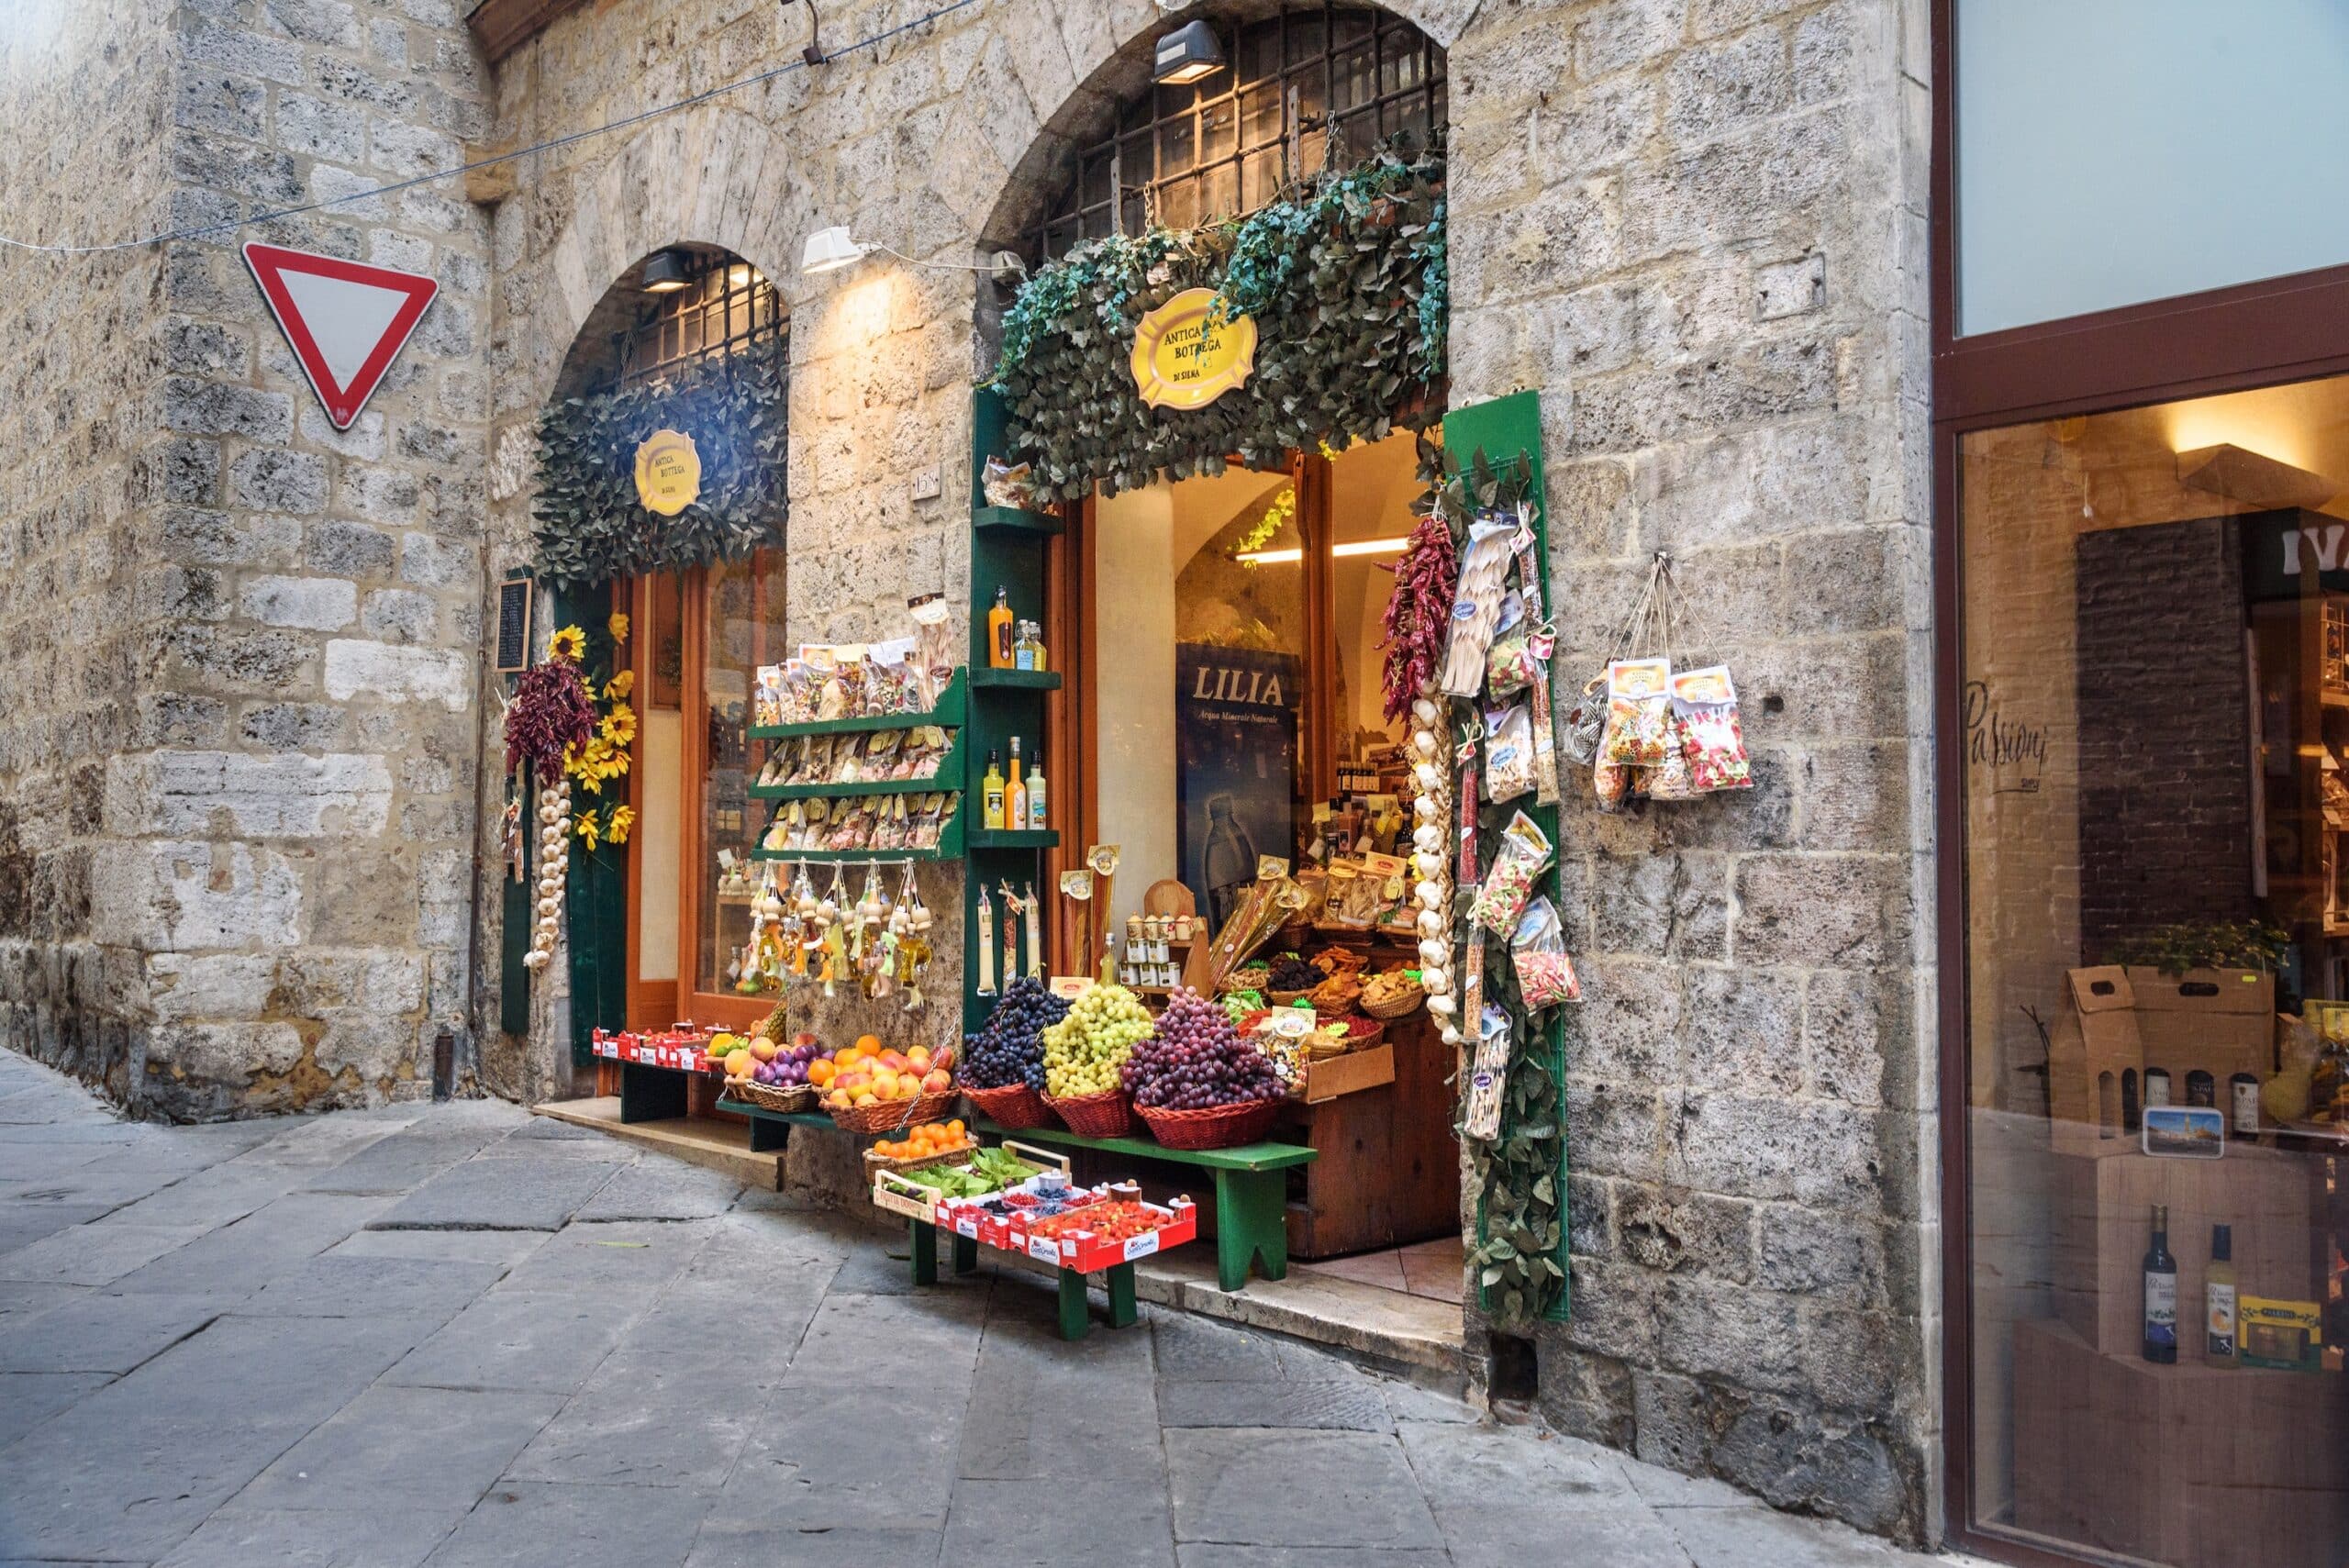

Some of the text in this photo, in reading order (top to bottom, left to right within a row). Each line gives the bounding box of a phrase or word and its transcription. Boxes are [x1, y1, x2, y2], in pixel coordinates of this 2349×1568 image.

[1164, 327, 1201, 345] ANTICA
[1174, 373, 1180, 382] DI
[655, 455, 674, 467] ANTICA
[661, 465, 685, 477] BOTTEGA
[1193, 666, 1284, 706] LILIA
[1197, 709, 1278, 724] Acqua Minerale Naturale
[1966, 680, 2048, 776] Passioni
